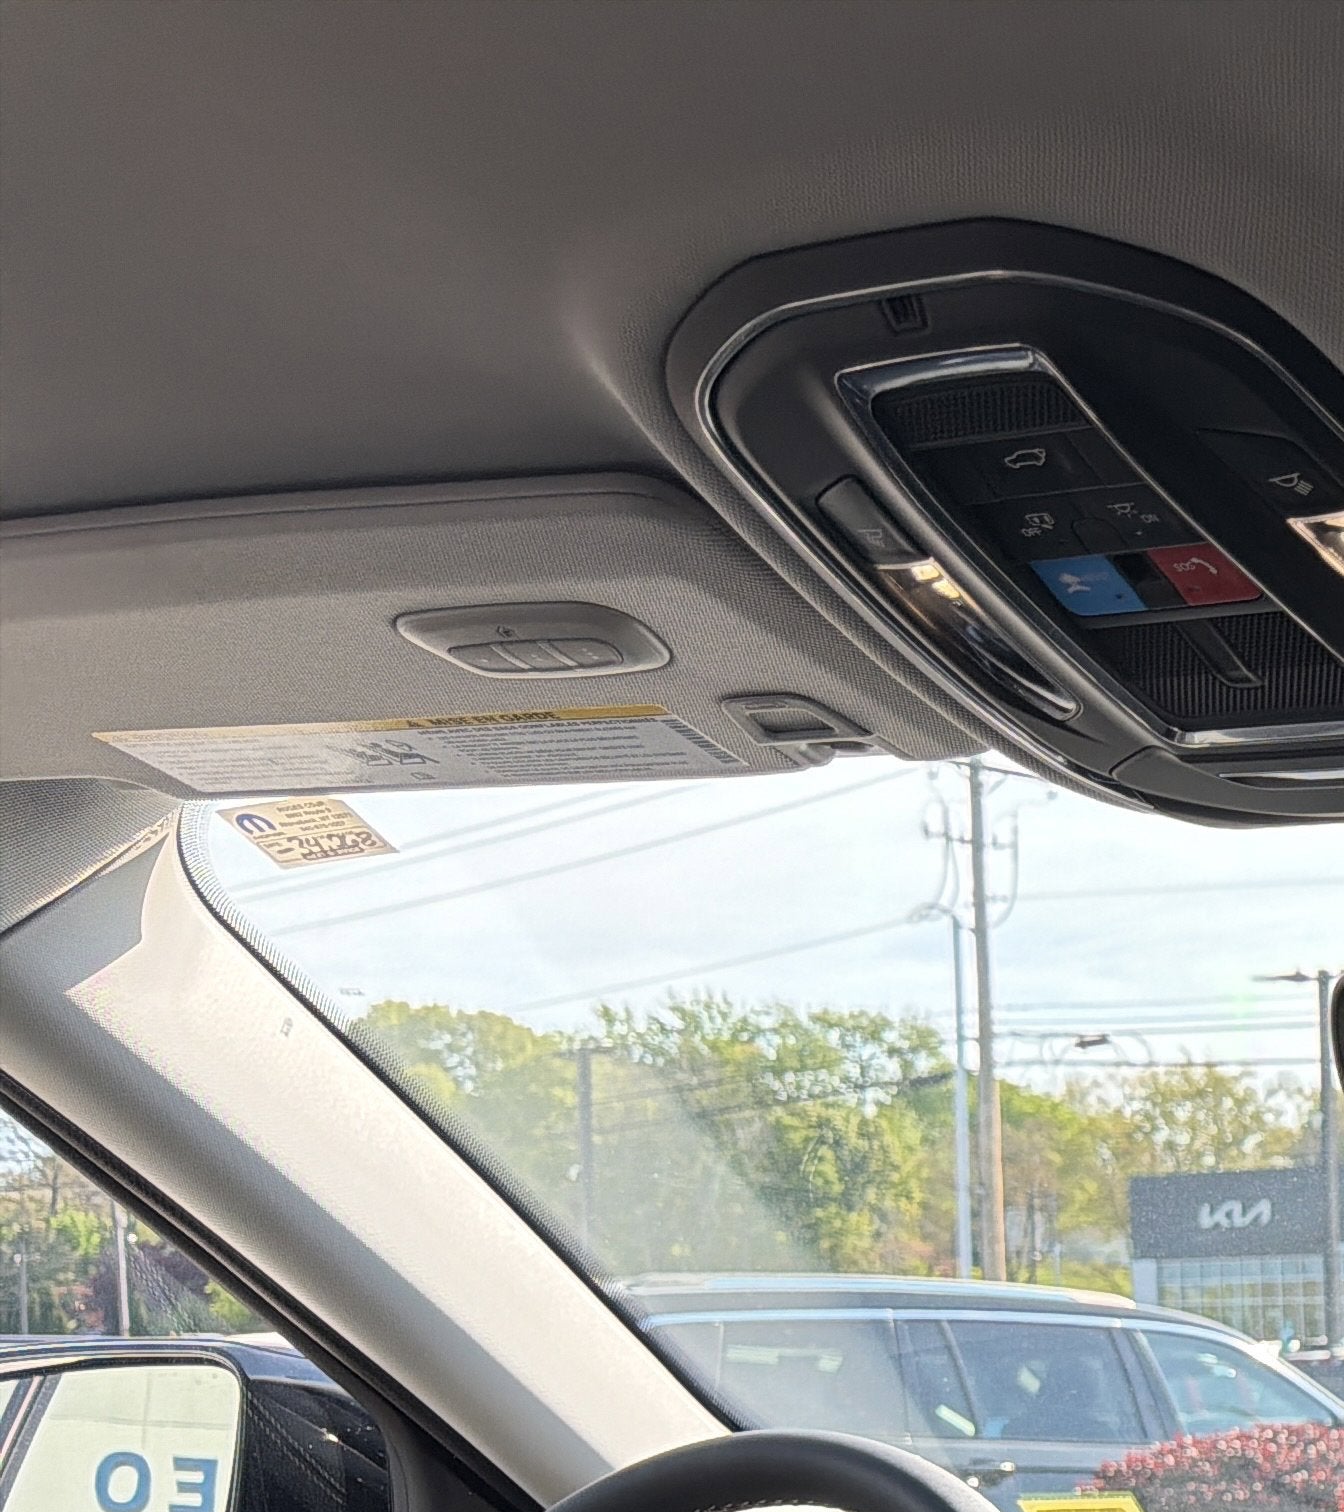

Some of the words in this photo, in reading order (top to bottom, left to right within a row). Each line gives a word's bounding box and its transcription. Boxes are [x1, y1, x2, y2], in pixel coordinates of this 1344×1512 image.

[430, 715, 476, 727] MISE
[479, 713, 498, 725] EN
[500, 710, 561, 724] GARDE
[1200, 1198, 1273, 1230] KIA
